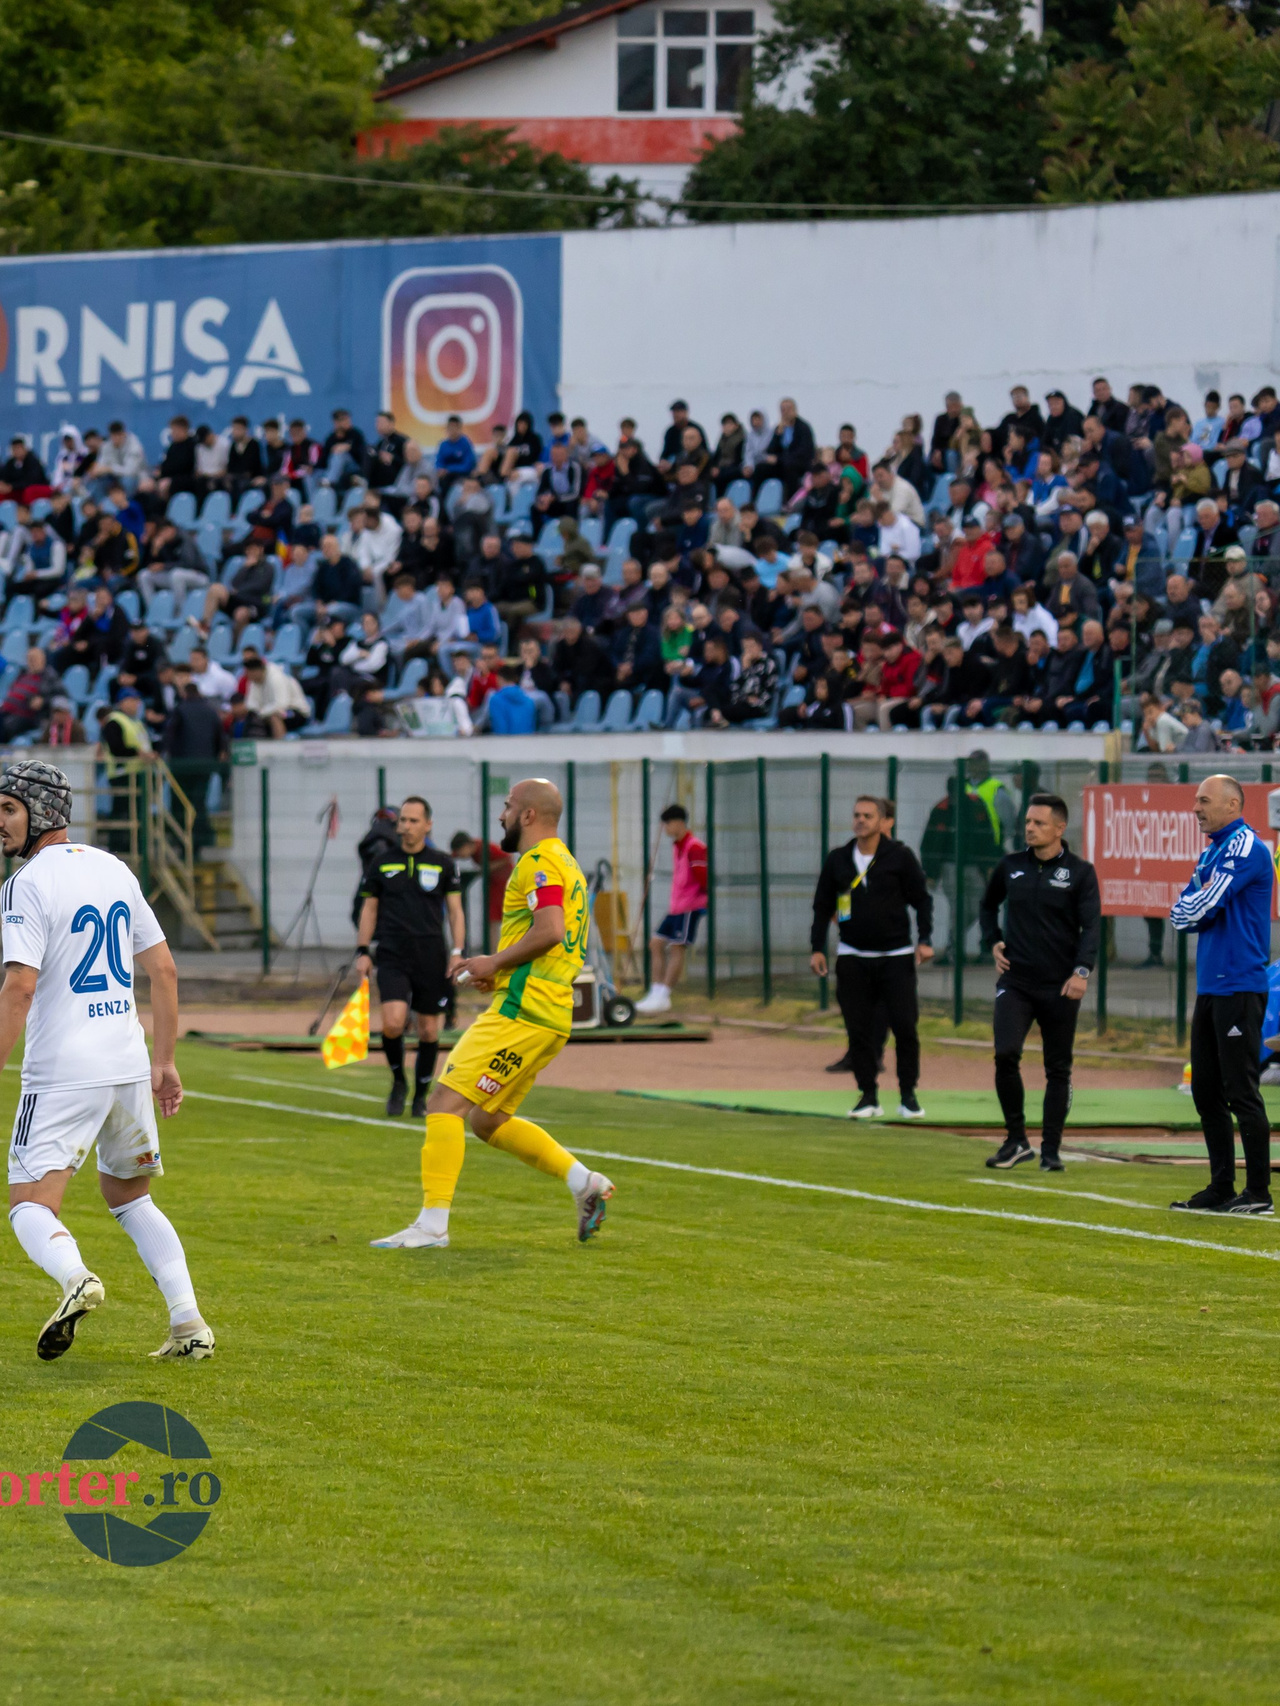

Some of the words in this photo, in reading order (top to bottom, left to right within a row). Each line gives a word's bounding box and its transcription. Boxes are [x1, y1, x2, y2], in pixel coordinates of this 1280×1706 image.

[69, 900, 131, 994] 20
[488, 1057, 513, 1078] DIN
[495, 1047, 523, 1070] APA
